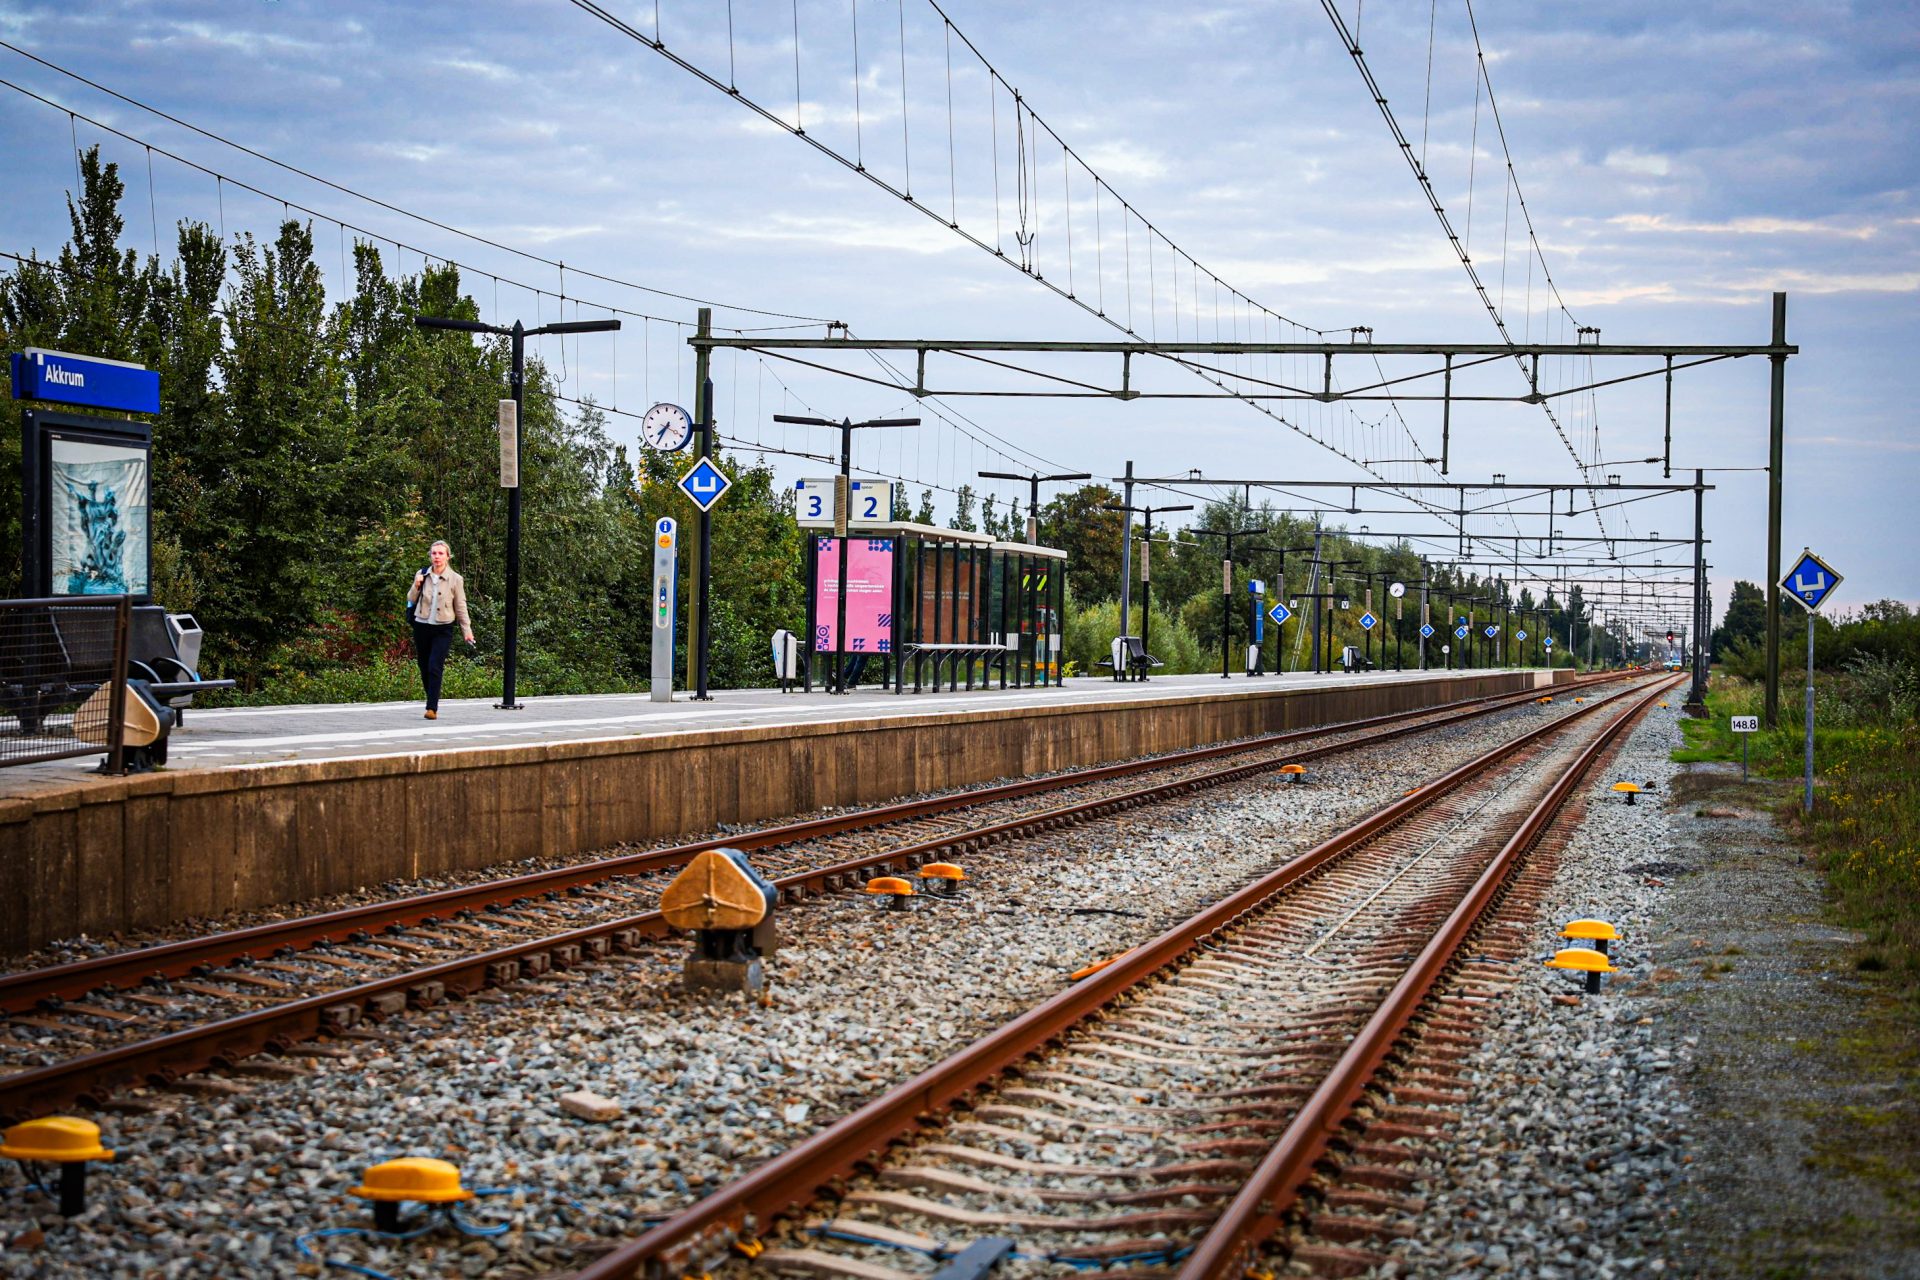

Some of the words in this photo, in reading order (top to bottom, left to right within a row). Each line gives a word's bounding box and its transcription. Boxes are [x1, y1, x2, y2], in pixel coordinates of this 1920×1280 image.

[45, 364, 84, 387] Akkrum
[808, 496, 821, 516] 3
[864, 497, 877, 517] 2
[1277, 610, 1283, 618] 3
